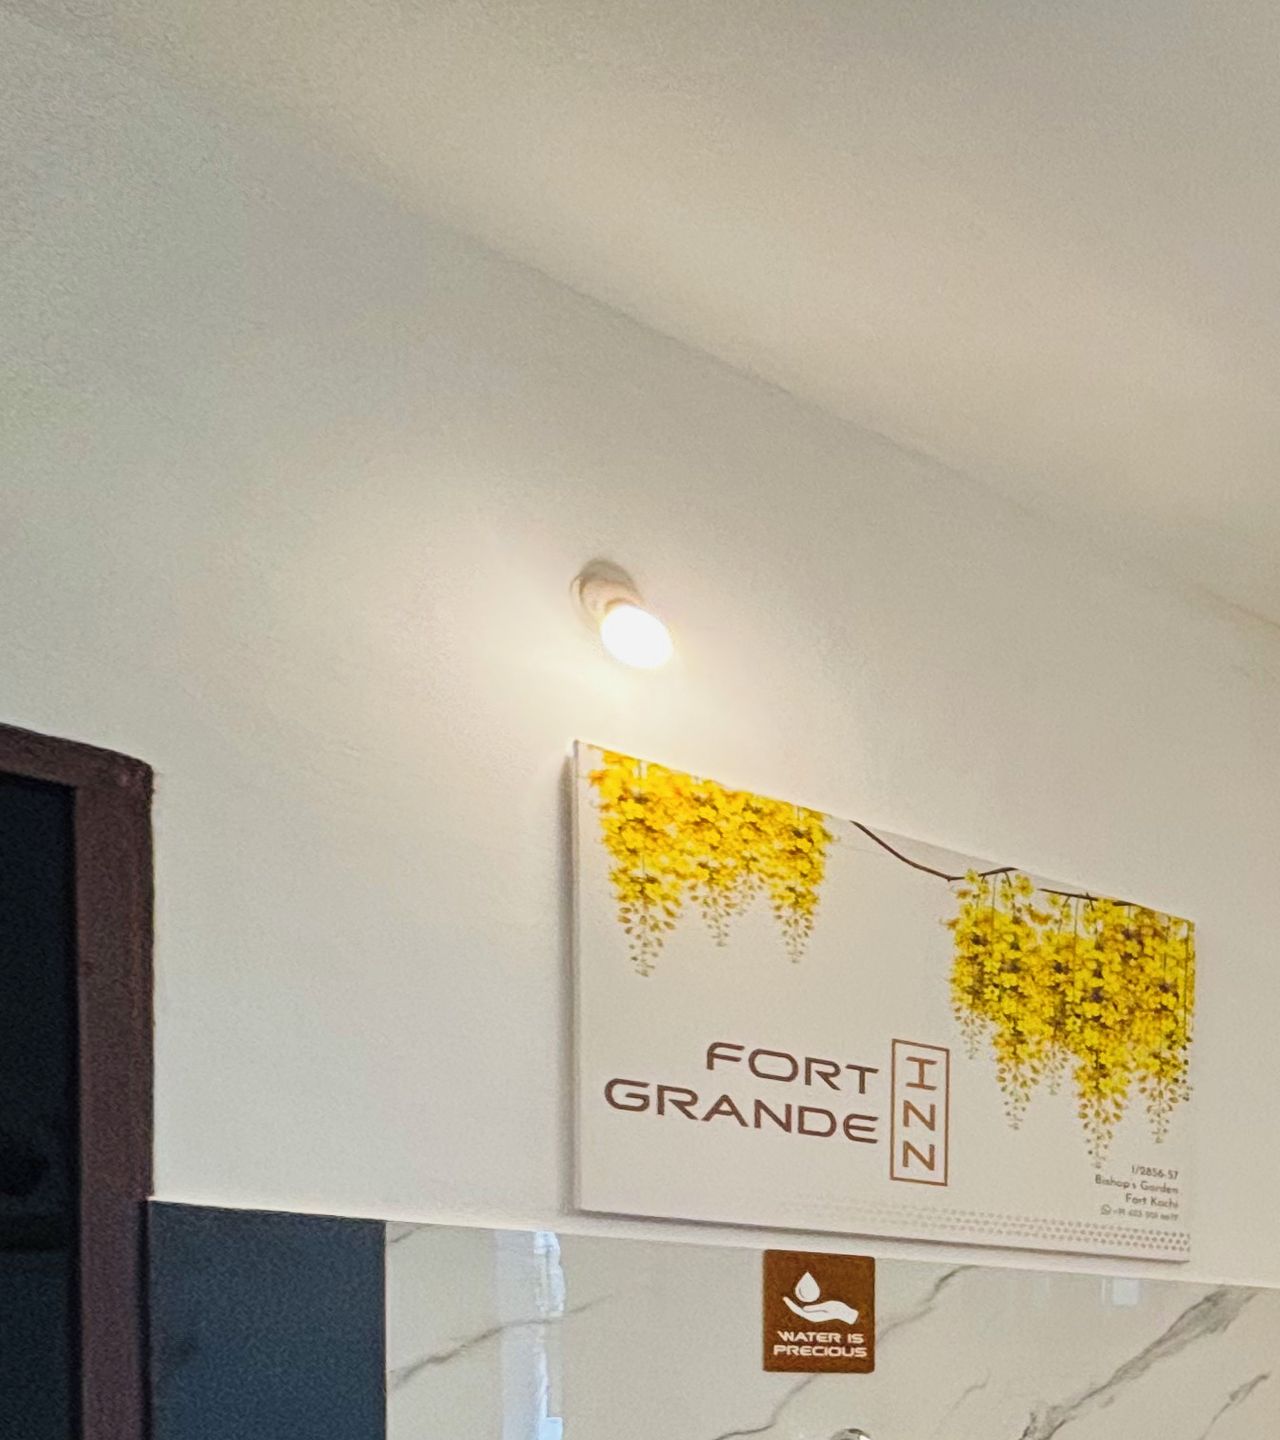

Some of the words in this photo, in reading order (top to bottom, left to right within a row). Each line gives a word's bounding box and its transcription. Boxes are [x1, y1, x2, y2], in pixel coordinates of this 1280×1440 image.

[706, 1042, 879, 1094] FORT
[604, 1078, 878, 1144] GRANDE
[902, 1055, 938, 1172] INN
[1140, 1180, 1179, 1194] Garden
[1126, 1193, 1147, 1205] Fort
[1150, 1196, 1179, 1209] Kochi
[777, 1331, 842, 1344] WATER
[847, 1333, 865, 1344] IS
[773, 1344, 868, 1358] PRECIOUS
